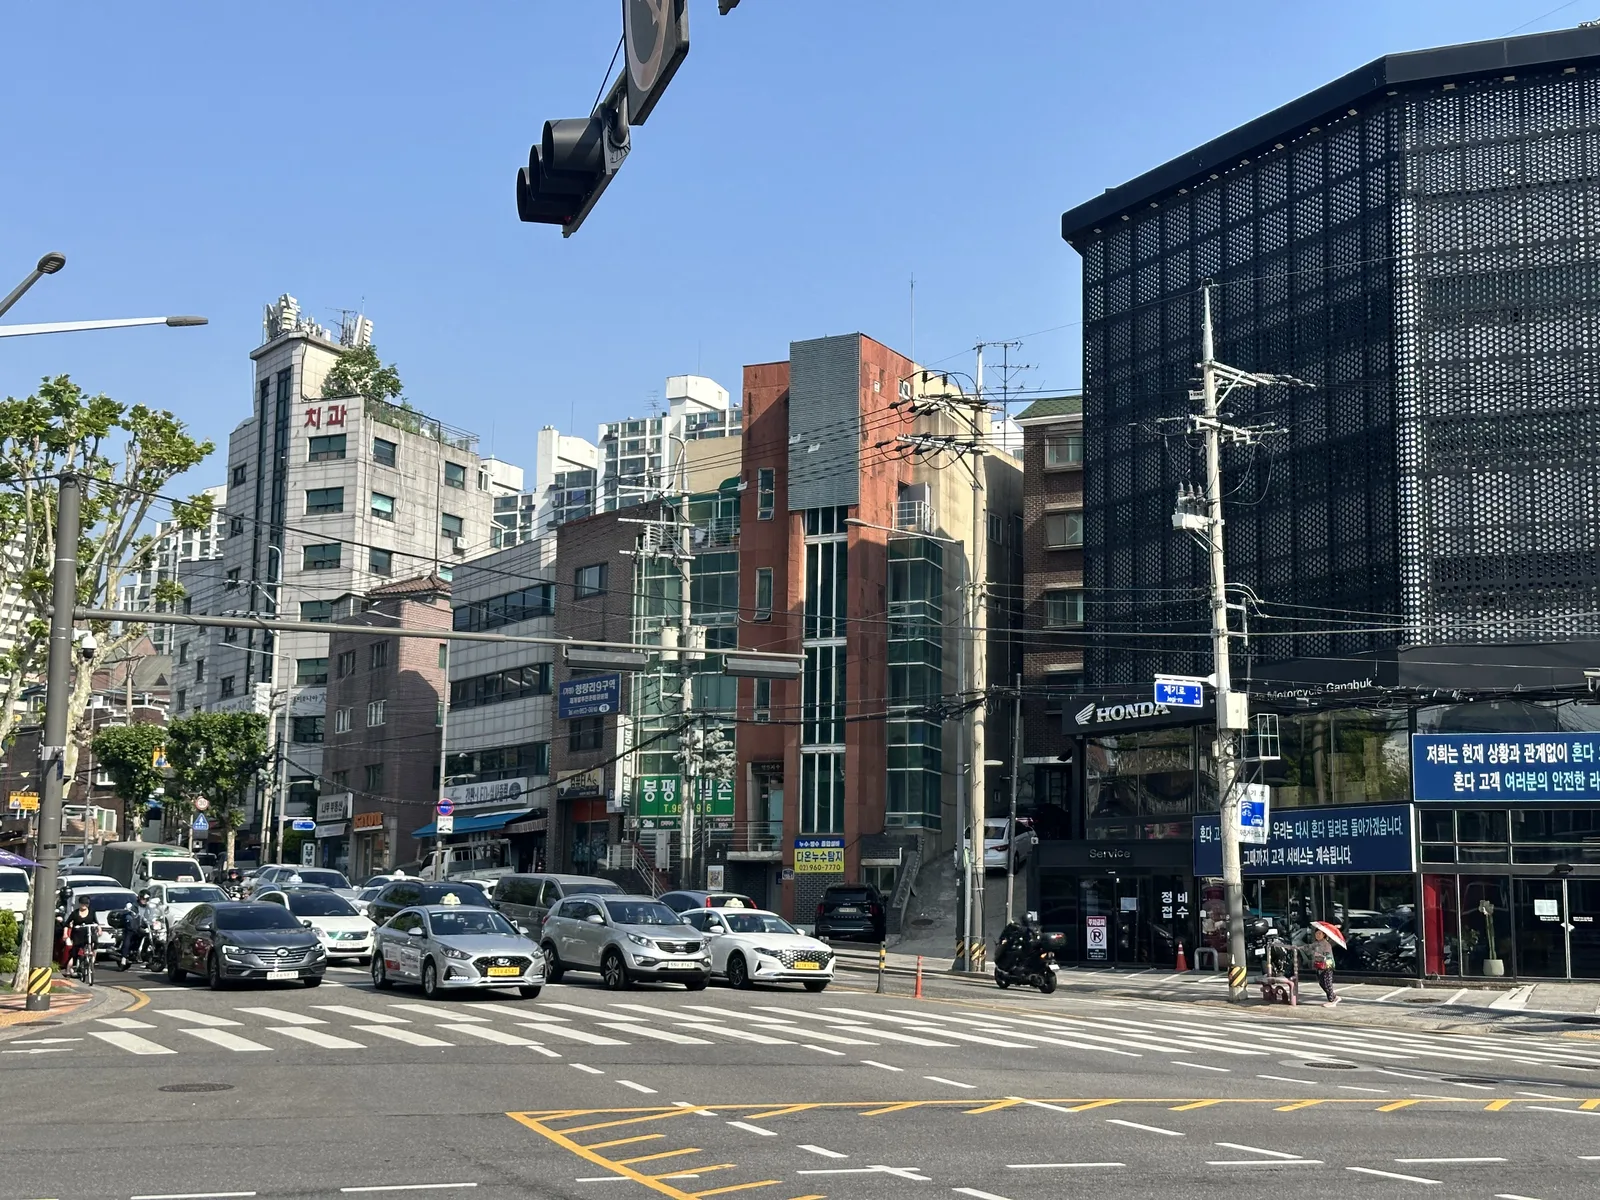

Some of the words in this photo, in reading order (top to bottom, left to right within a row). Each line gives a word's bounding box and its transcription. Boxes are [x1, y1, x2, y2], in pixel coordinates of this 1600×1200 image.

[304, 404, 347, 430] 치과
[1163, 685, 1186, 695] 제기로
[1326, 678, 1373, 694] Gangbuk
[1096, 702, 1171, 723] HONDA
[1427, 744, 1459, 764] 저희는
[1462, 744, 1484, 764] 현재
[1488, 743, 1520, 764] 상황과
[1524, 743, 1568, 763] 관계없이
[1572, 743, 1594, 763] 혼다
[643, 778, 733, 802] 봉평밀촌
[1454, 772, 1475, 792] 혼다
[1479, 772, 1501, 792] 고객
[1505, 771, 1548, 792] 여러분의
[1552, 771, 1585, 792] 안전한
[1200, 825, 1212, 842] 혼다
[1273, 820, 1293, 840] 우리는
[1295, 821, 1309, 838] 다시
[1311, 820, 1325, 838] 혼다
[1328, 819, 1349, 837] 딜러로
[1351, 816, 1403, 836] 돌아가겠습니다.
[796, 851, 843, 863] 다온누수탐지
[1089, 849, 1131, 859] Service
[1243, 848, 1269, 867] 그때까지
[1271, 847, 1284, 866] 고객
[1287, 846, 1313, 866] 서비스는
[1315, 845, 1352, 865] 계속됩니다.
[1161, 891, 1188, 904] 정비
[1161, 906, 1189, 919] 접수
